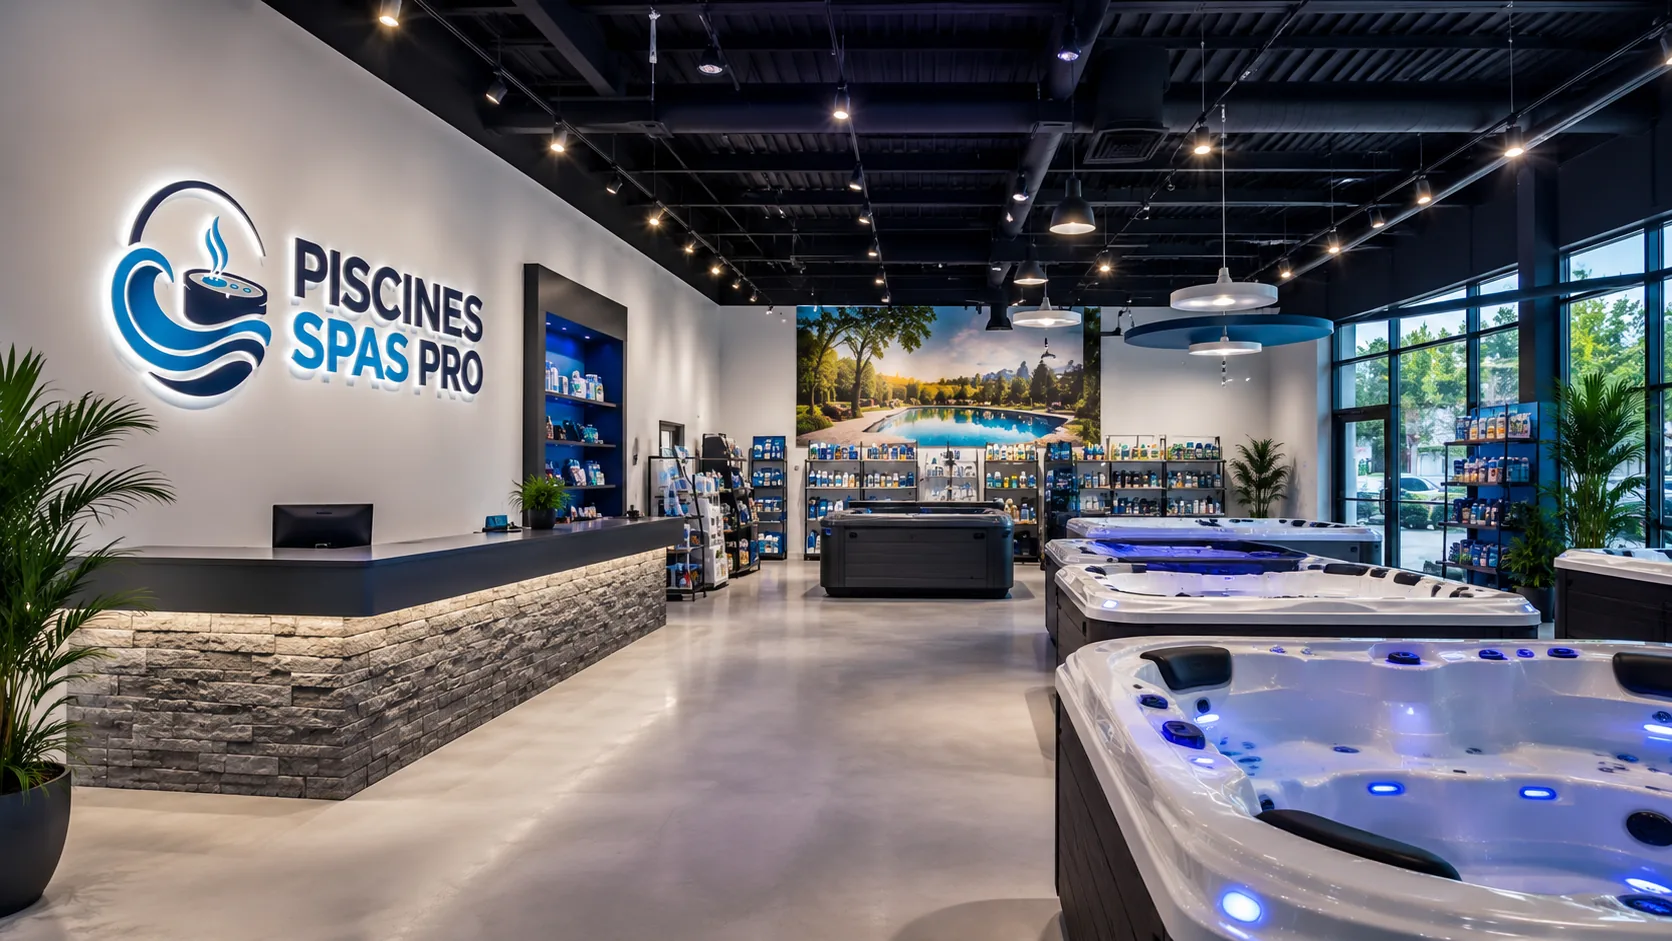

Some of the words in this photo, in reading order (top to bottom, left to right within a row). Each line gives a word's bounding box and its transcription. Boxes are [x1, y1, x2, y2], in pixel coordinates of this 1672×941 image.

[294, 237, 483, 343] PISCINES
[292, 311, 409, 382] SPAS
[419, 340, 483, 394] PRO
